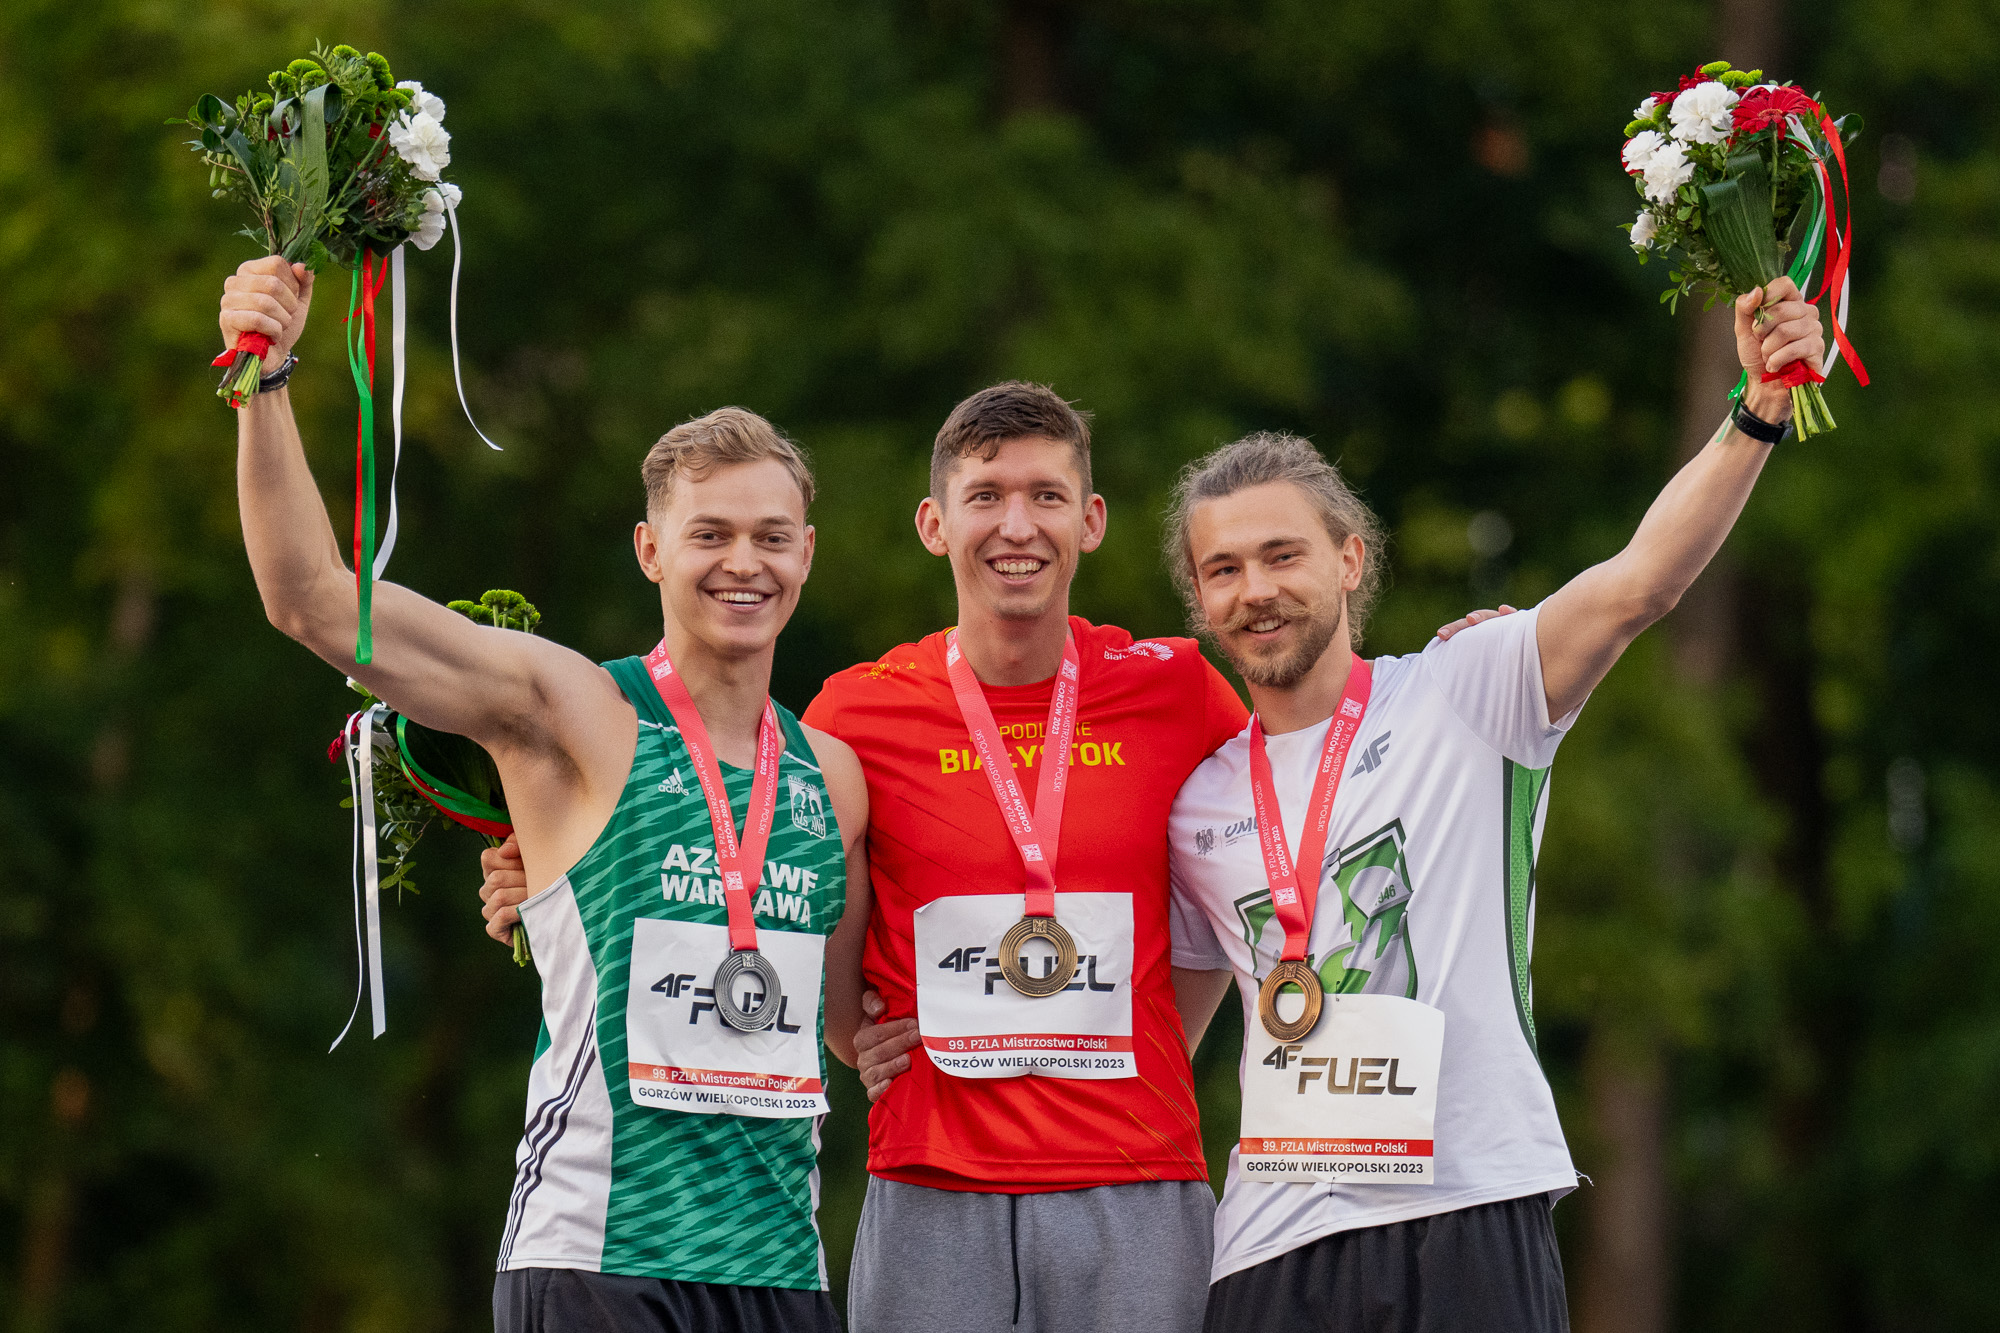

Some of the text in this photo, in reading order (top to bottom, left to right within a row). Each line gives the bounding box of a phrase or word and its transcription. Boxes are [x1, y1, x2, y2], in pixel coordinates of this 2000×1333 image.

[1052, 681, 1066, 735] GORZÓW 2023
[1065, 697, 1074, 714] PZLA
[974, 729, 989, 754] POLSKI
[1000, 722, 1092, 740] PODLIE
[1057, 714, 1070, 765] MISTRZOSTWA
[1340, 734, 1350, 750] PZLA
[690, 742, 705, 768] POLSKI
[939, 742, 1126, 774] BIYTOK
[1322, 720, 1344, 773] GORZÓW 2023
[985, 754, 1009, 804] MISTRZOSTWA
[1053, 767, 1064, 792] POLSKI
[1323, 750, 1344, 803] MISTRZOSTWA
[700, 770, 720, 823] MISTRZOSTWA
[1255, 780, 1263, 804] POLSKI
[1005, 779, 1032, 833] GORZÓW 2023
[1006, 804, 1018, 823] PZLA
[1317, 804, 1328, 832] POLSKI
[719, 799, 736, 858] GORZÓW 2023
[758, 808, 770, 835] POLSKI
[1259, 805, 1272, 851] MISTRZOSTWA
[716, 825, 725, 845] PZLA
[1272, 825, 1289, 877] GORZÓW 2023
[760, 861, 818, 896] WF
[660, 874, 811, 928] WARAWA
[938, 946, 986, 972] 4F
[650, 973, 696, 998] 4F
[948, 1037, 1107, 1050] 99. PZLA Mistrzostwa Polski
[934, 1056, 1125, 1069] GORZÓW WIELKOPOLSKI 2023
[1263, 1045, 1417, 1095] 4F FUEL
[652, 1069, 797, 1091] 99. PZLA Mistrzostwa Polski
[638, 1087, 816, 1109] GORZÓW WIELKOPOLSKI 2023
[1262, 1141, 1407, 1154] 99. PZLA Mistrzostwa Polski
[1247, 1159, 1423, 1173] GORZÓW WIELKOPOLSKI 2023
